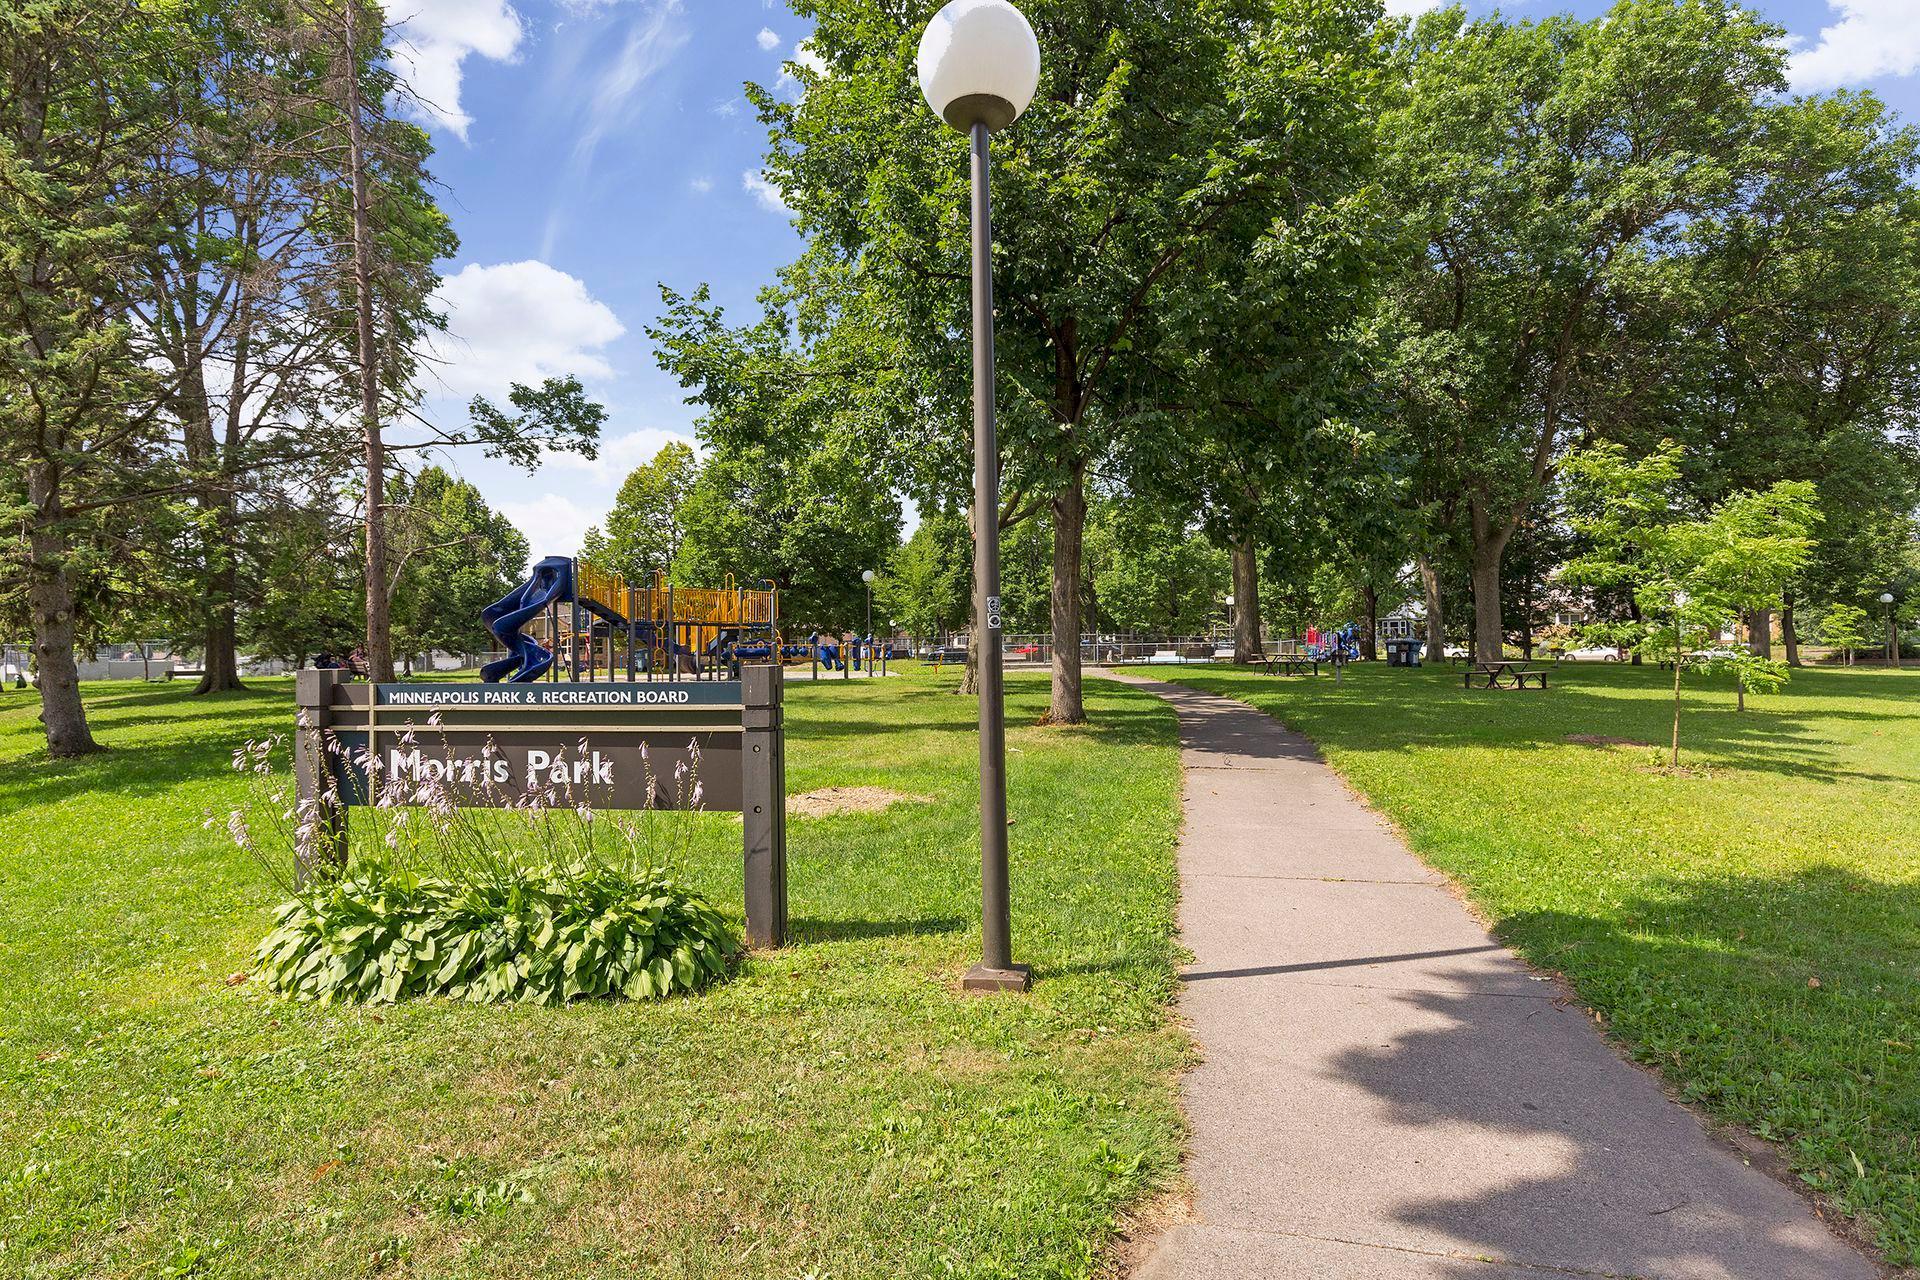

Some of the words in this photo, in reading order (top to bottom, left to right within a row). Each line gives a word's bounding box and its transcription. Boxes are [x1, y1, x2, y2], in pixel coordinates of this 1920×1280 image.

[389, 692, 479, 704] MINNEAPOLIS
[484, 692, 520, 704] PARK
[525, 692, 537, 704] &
[542, 691, 631, 704] RECREATION
[637, 691, 689, 704] BOARD
[390, 749, 509, 783] Morris
[527, 750, 614, 785] Park
